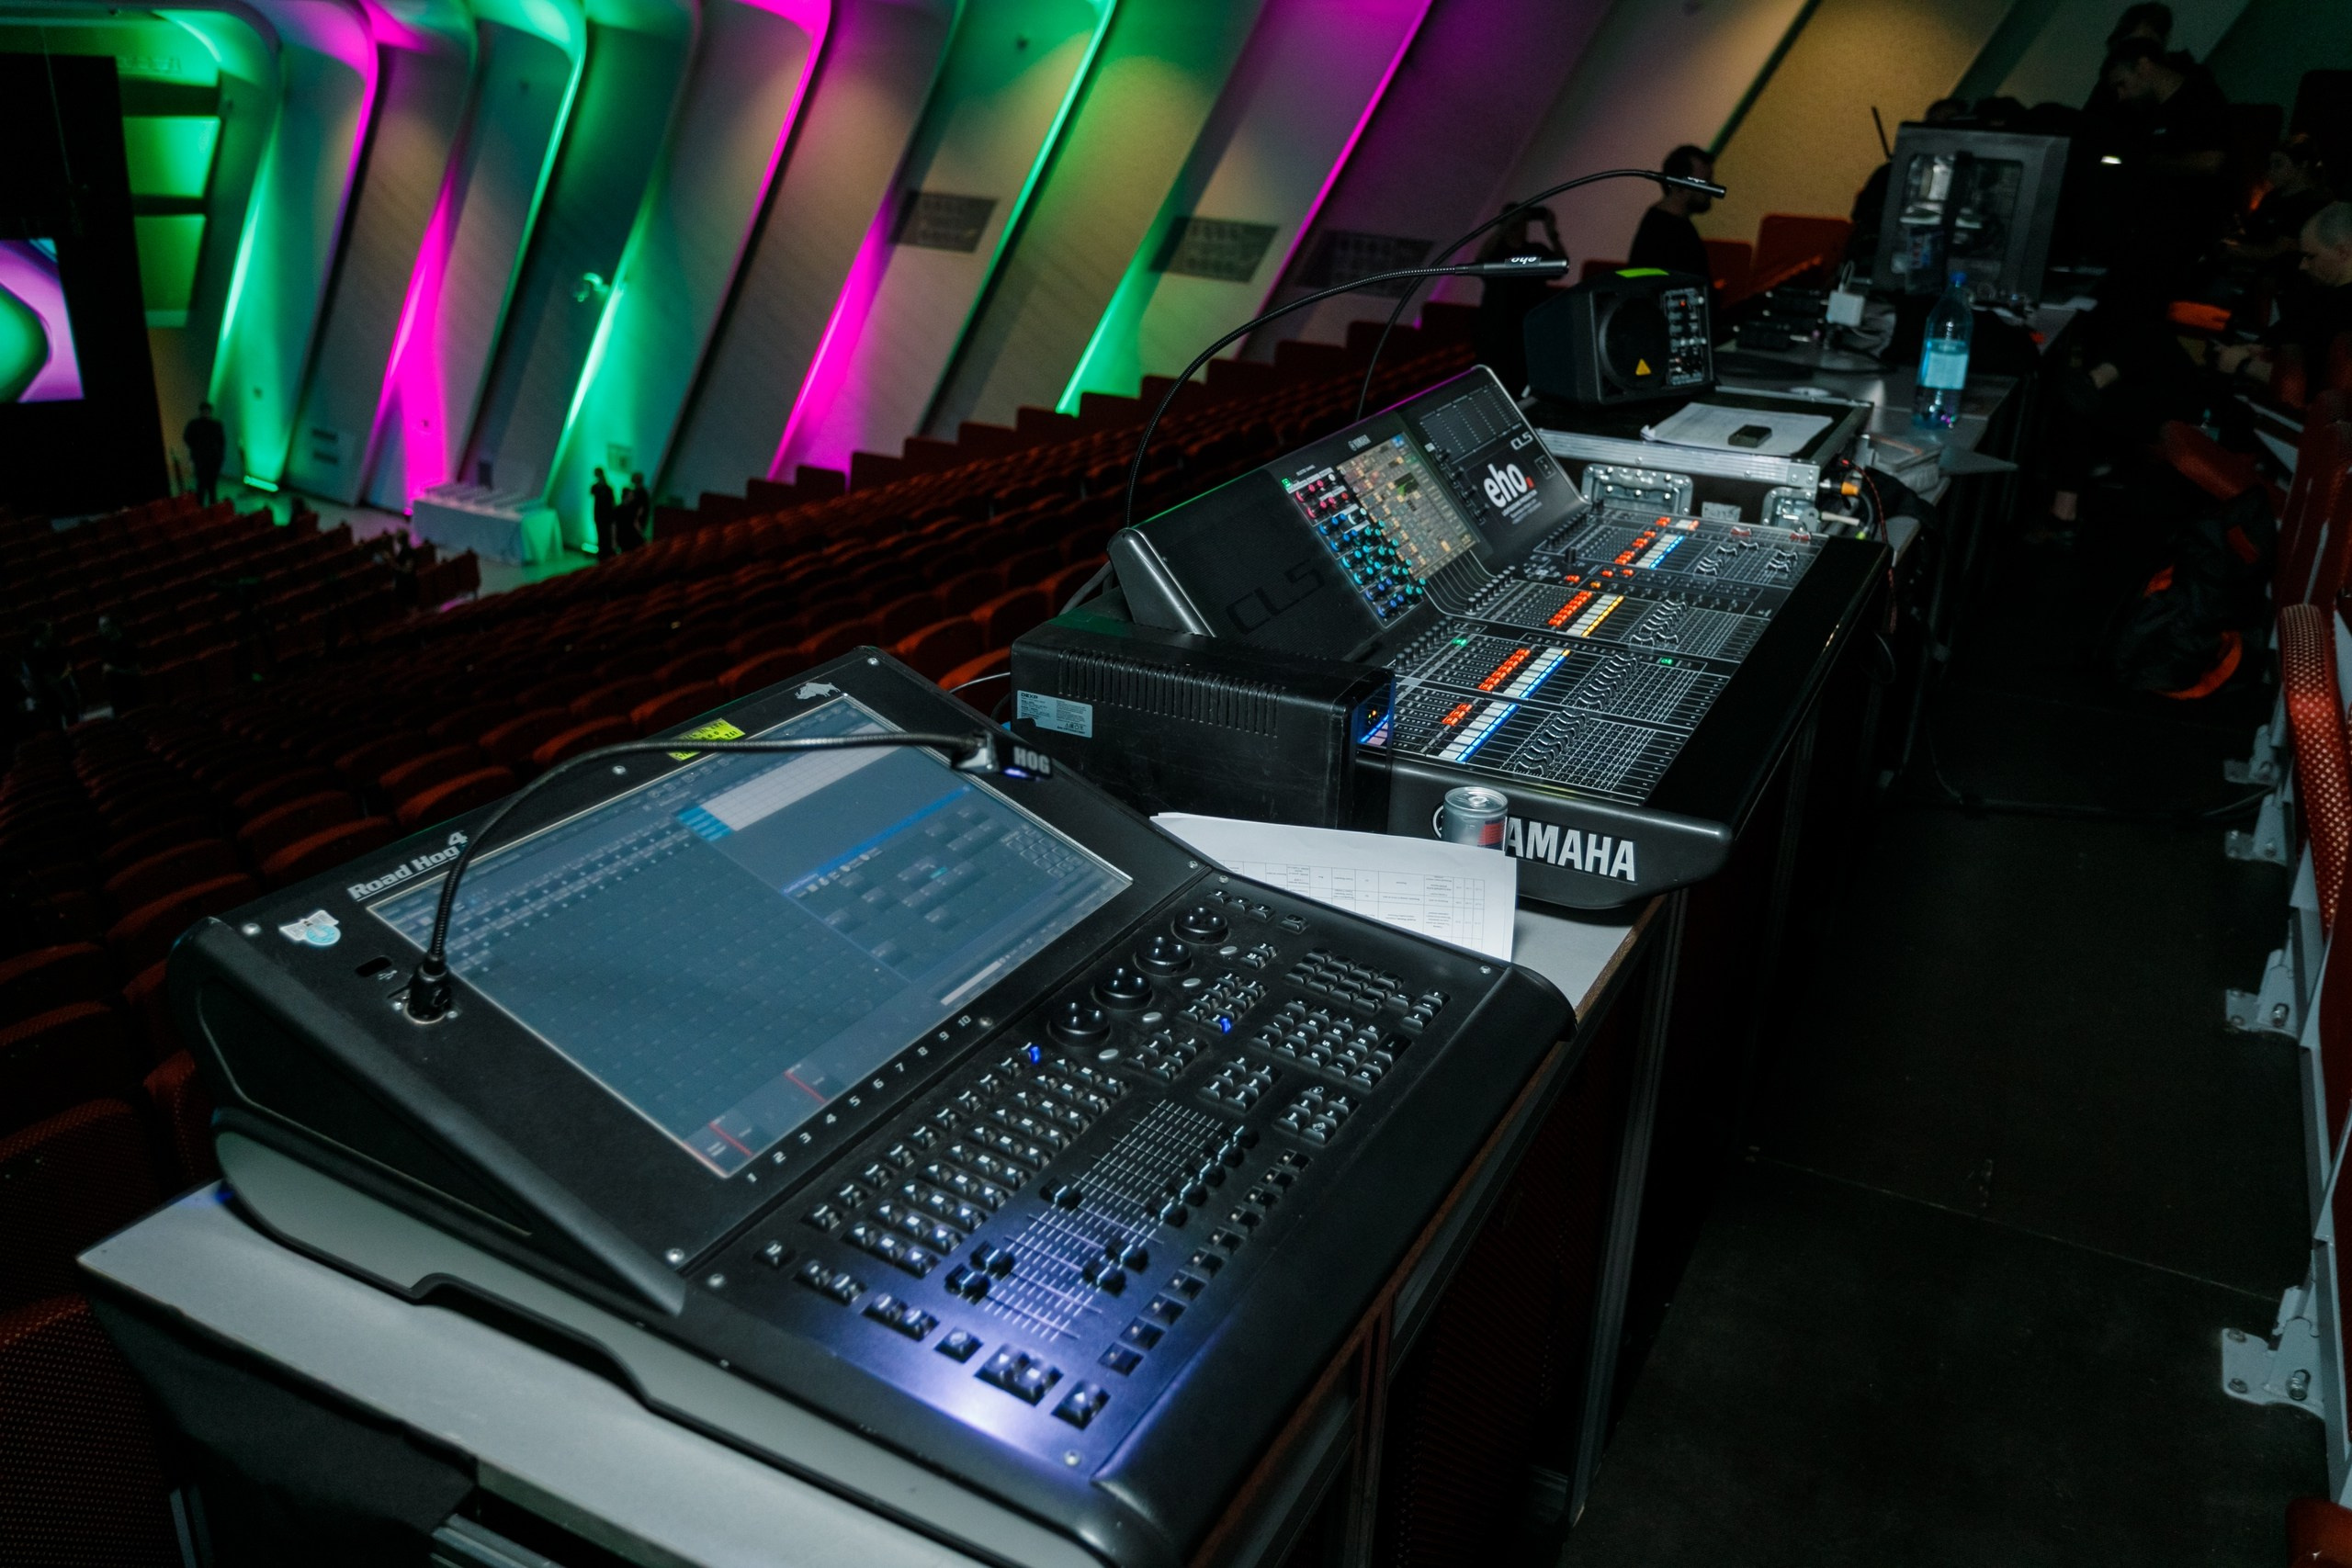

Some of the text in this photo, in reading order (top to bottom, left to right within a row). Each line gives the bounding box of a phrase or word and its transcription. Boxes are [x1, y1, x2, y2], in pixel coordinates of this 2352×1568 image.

[1014, 746, 1050, 774] HOG
[347, 864, 413, 900] Road
[412, 845, 460, 871] Hog
[1507, 817, 1635, 882] AMAHA
[747, 1015, 971, 1183] 1 2 3 4 5 6 7 8 9 10
